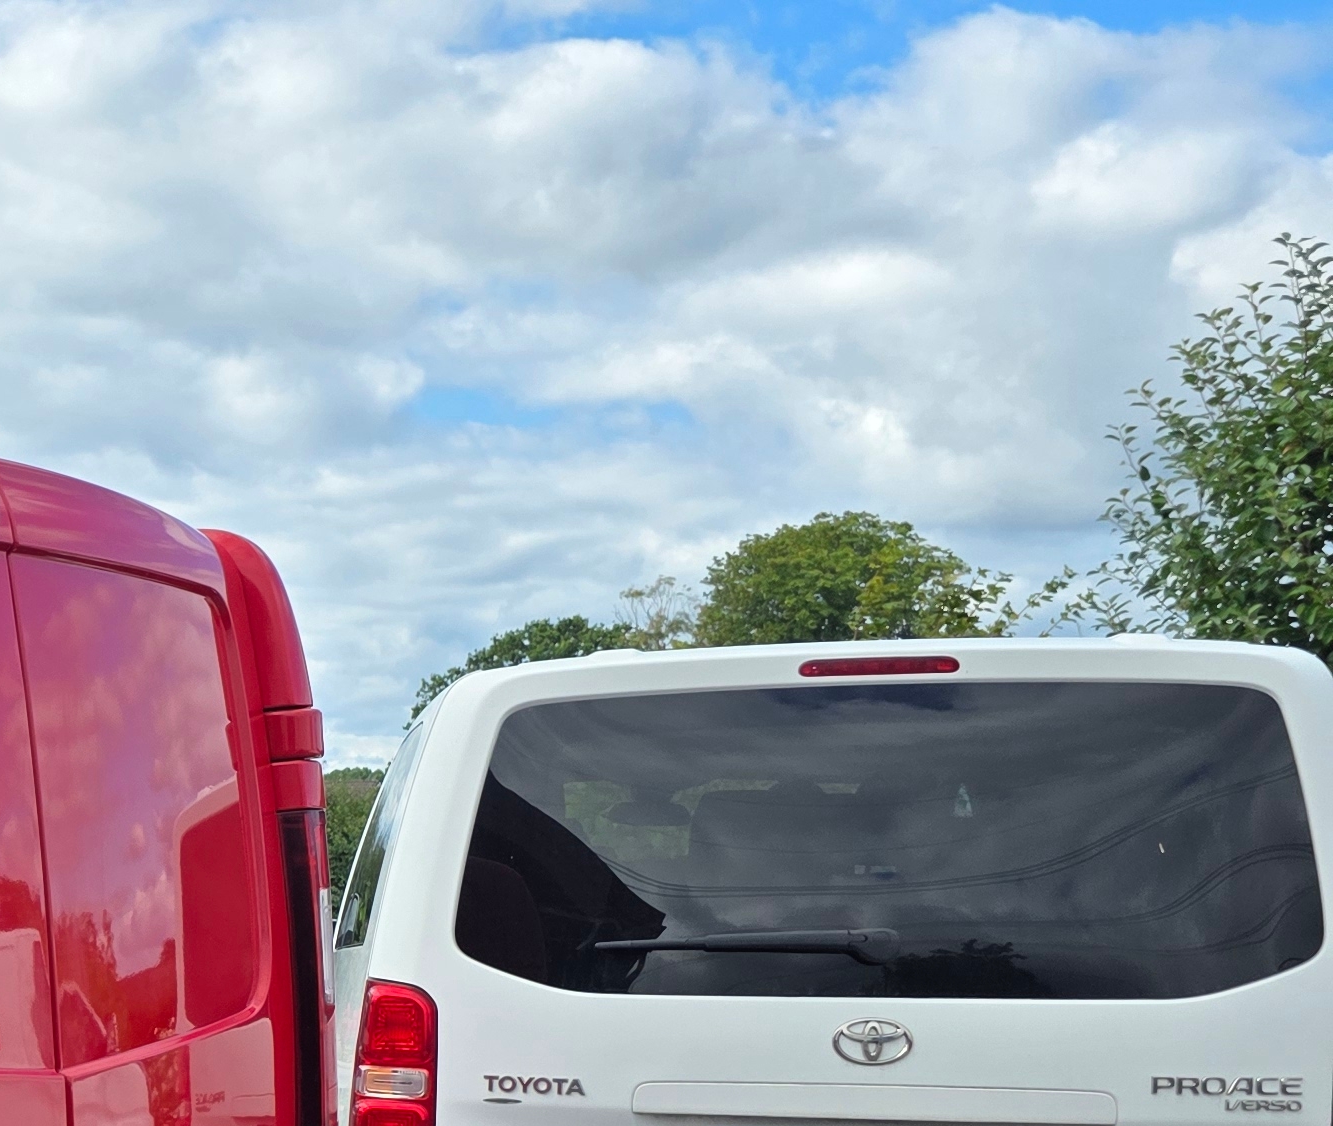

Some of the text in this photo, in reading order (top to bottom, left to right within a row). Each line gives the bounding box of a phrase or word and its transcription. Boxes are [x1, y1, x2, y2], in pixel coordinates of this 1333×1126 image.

[483, 1075, 585, 1096] TOYOTA
[1151, 1076, 1303, 1096] PROACE
[1225, 1100, 1302, 1112] VERSO
